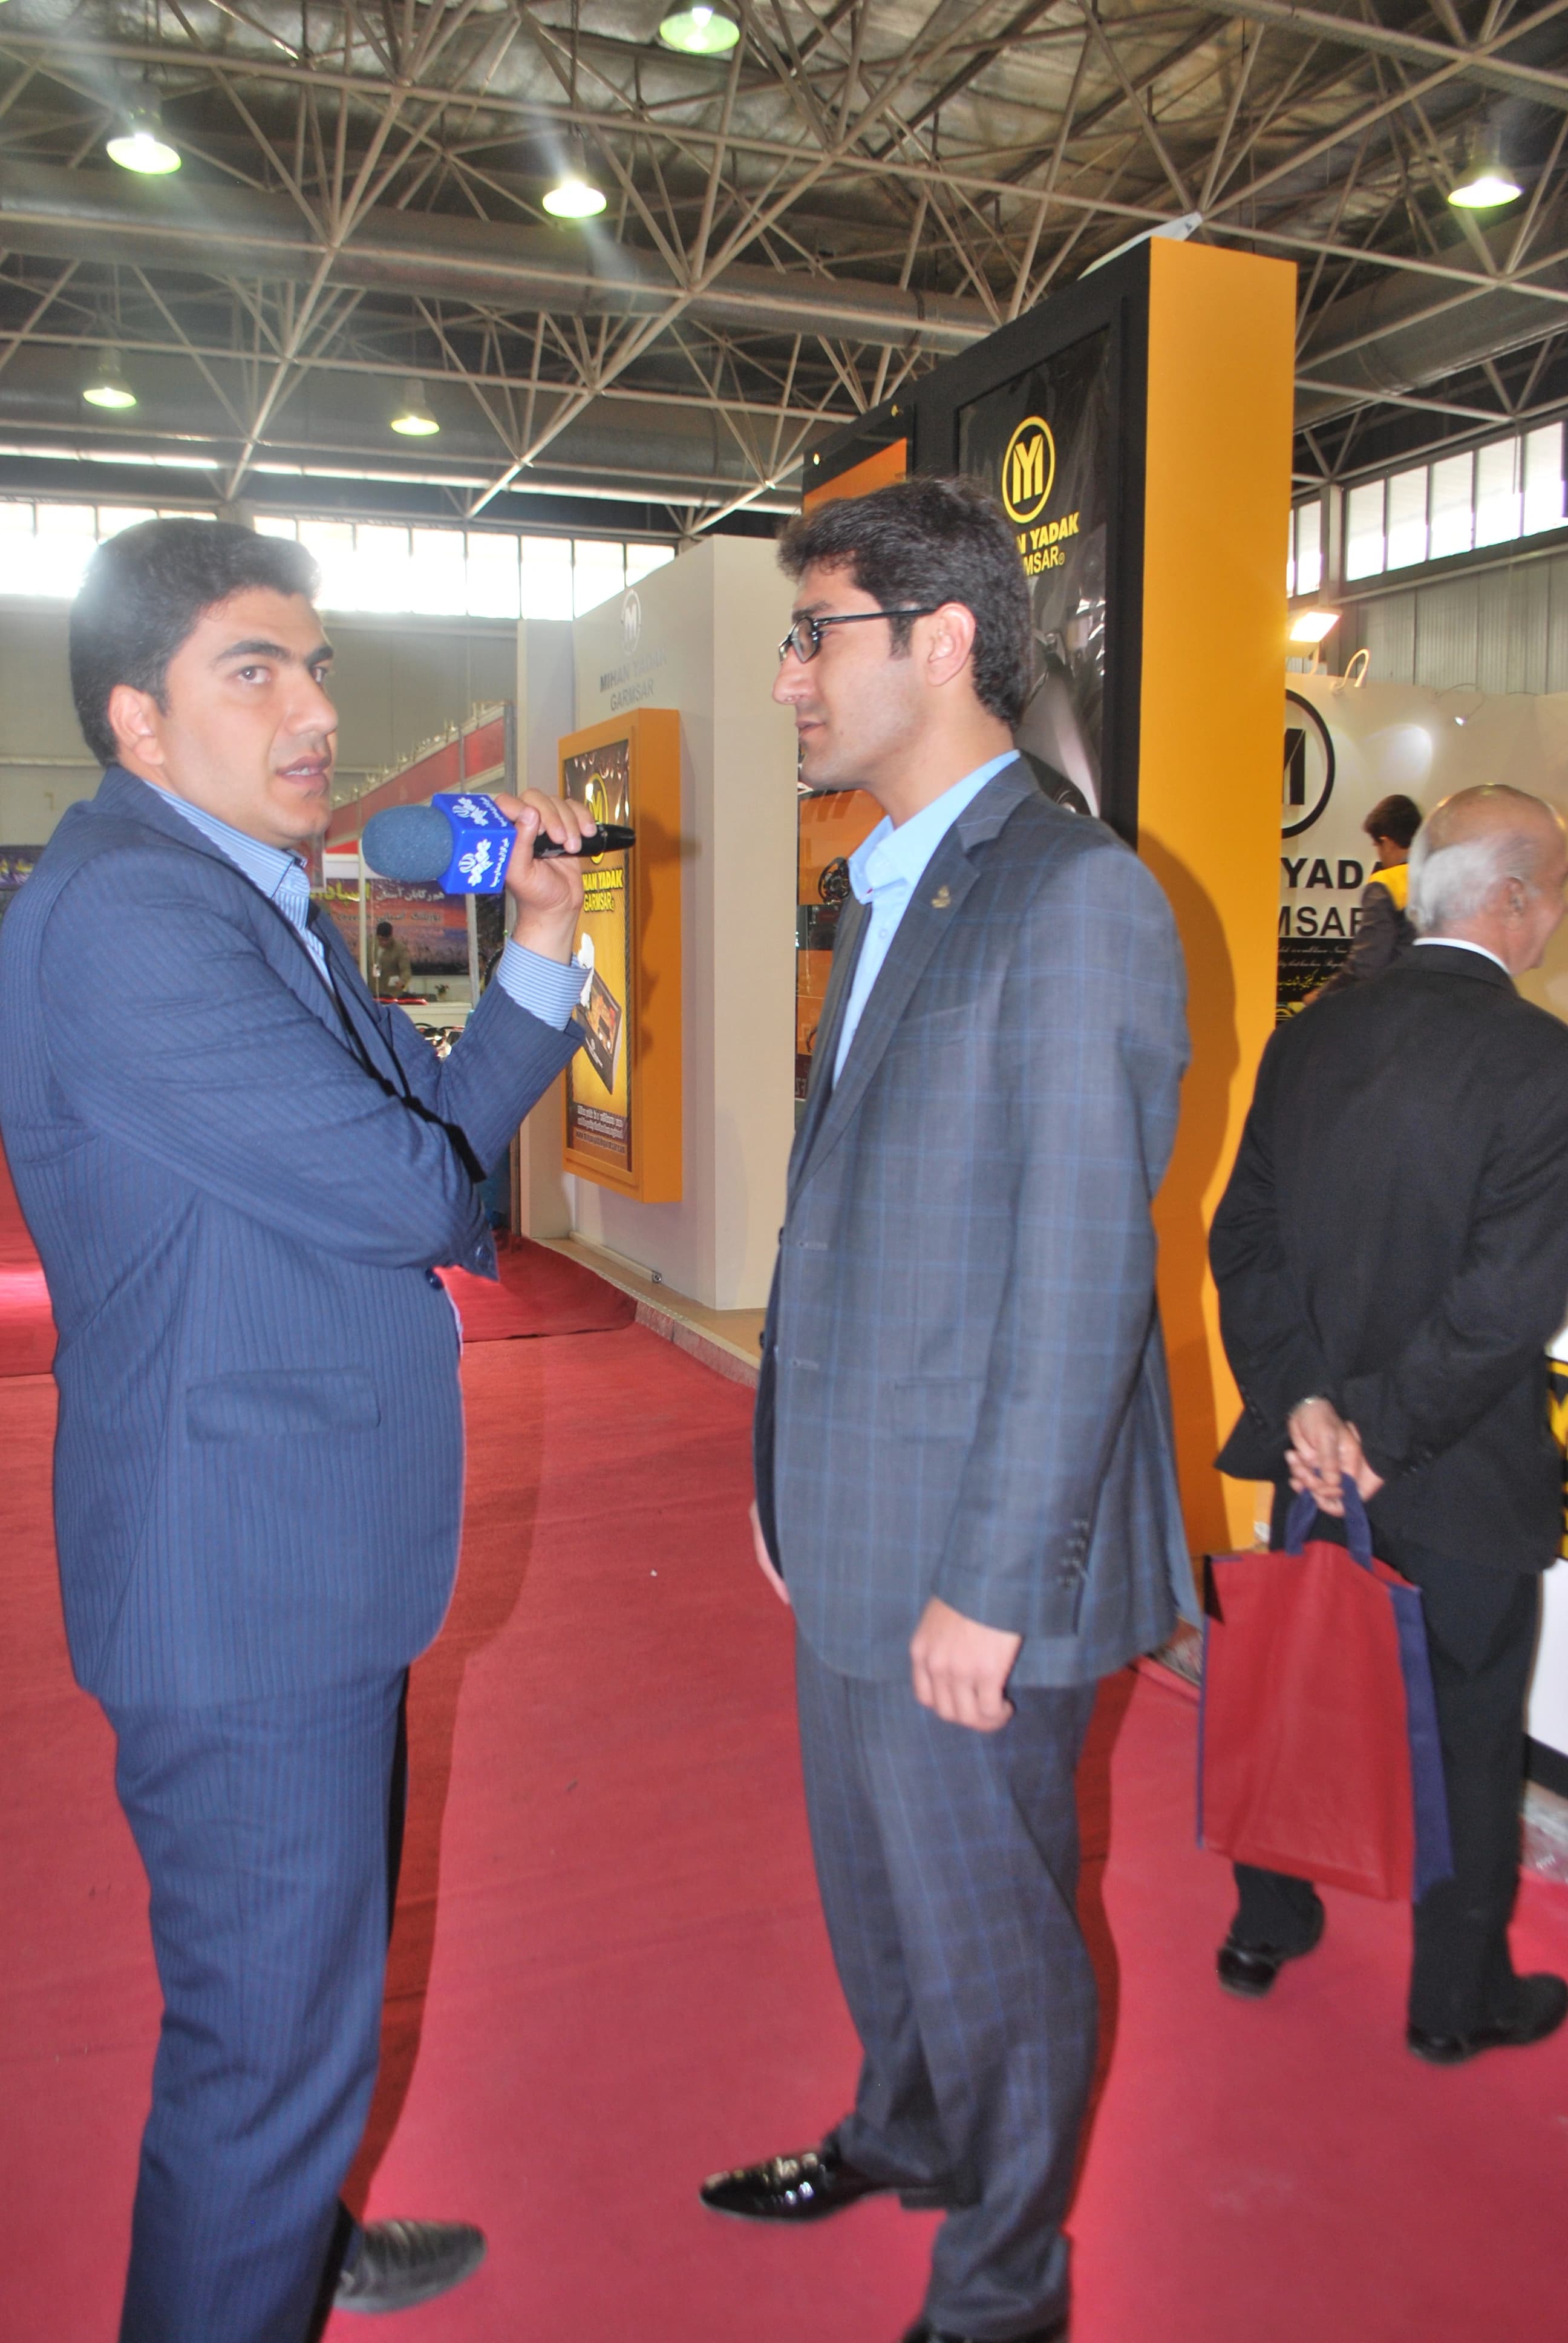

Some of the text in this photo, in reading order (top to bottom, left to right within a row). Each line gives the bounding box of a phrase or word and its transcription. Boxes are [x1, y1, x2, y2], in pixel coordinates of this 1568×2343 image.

[1030, 511, 1079, 550] YADAK
[599, 664, 630, 693] MIHAN
[610, 678, 654, 712] GARMSAR
[598, 868, 623, 890] YADAK
[1280, 857, 1383, 890] YAD
